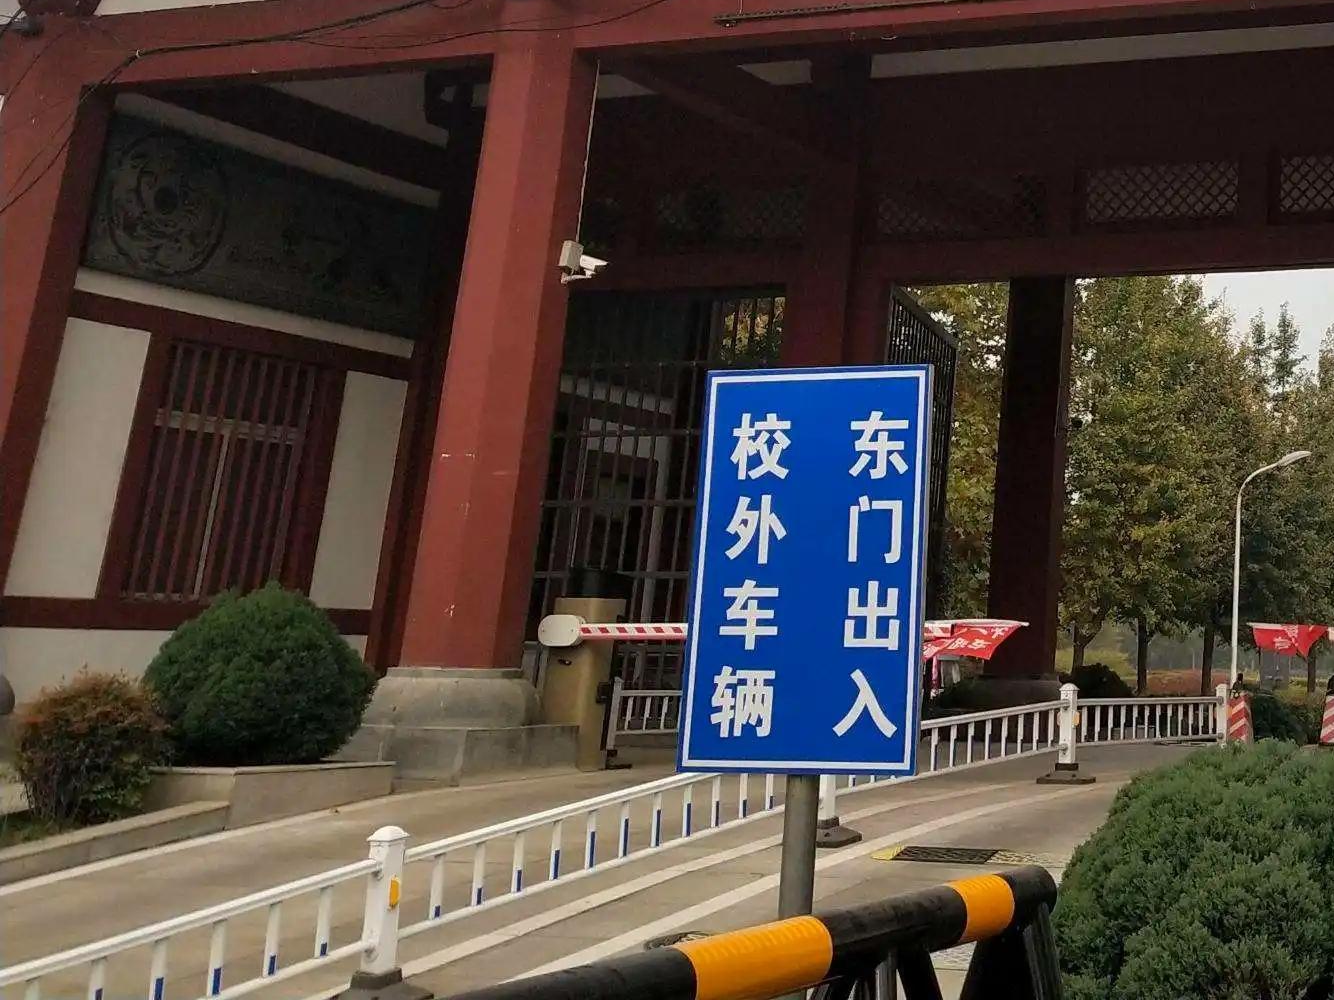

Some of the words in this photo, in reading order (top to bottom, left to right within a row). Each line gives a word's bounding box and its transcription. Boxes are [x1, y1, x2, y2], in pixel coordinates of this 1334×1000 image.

[710, 412, 791, 739] 校外车辆
[832, 410, 910, 739] 东门出入
